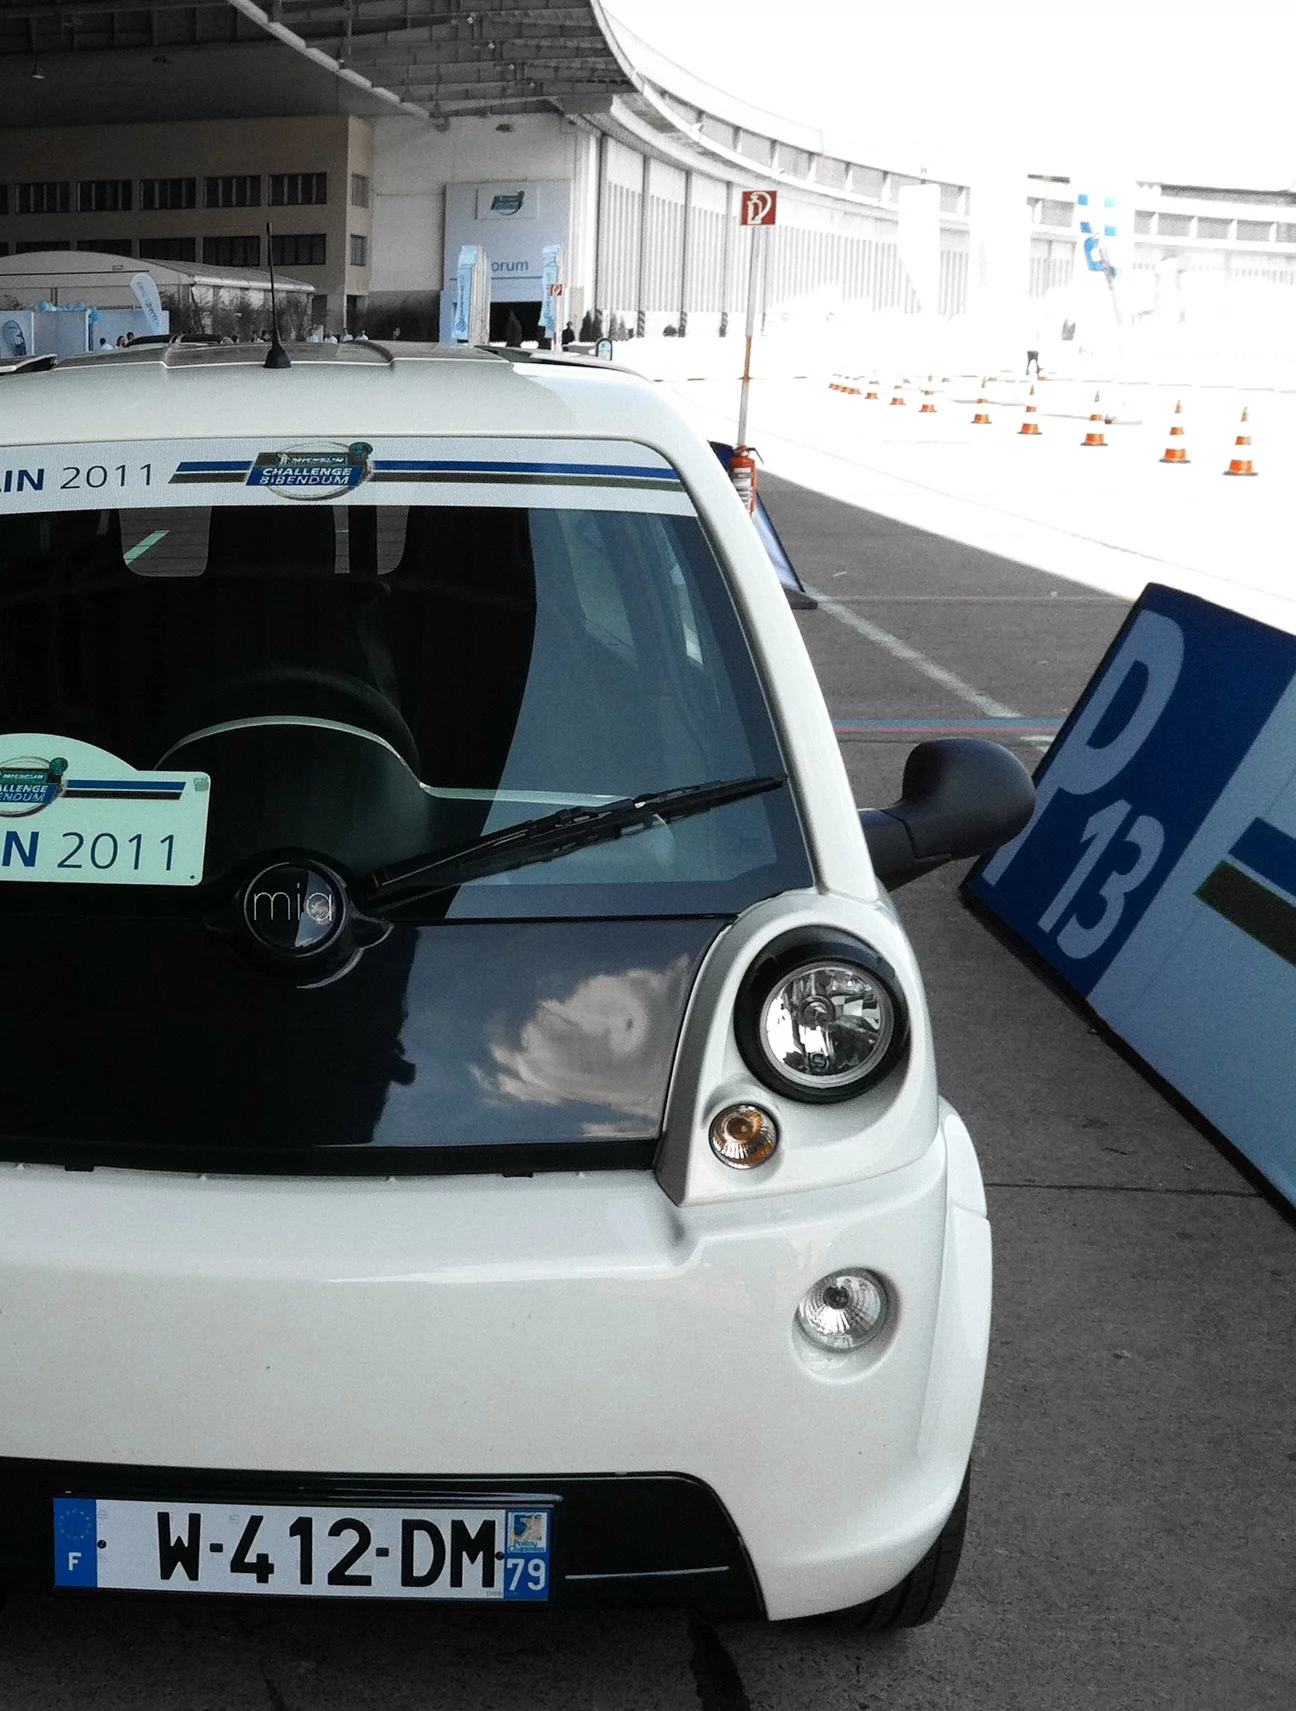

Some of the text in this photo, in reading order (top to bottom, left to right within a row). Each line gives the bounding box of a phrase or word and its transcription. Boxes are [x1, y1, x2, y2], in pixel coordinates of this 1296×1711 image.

[491, 259, 529, 272] orum
[60, 463, 153, 490] 2011
[259, 475, 350, 485] BIBENDUM
[262, 467, 353, 476] CHALLENGE
[984, 608, 1185, 887] P
[57, 832, 177, 872] 2011
[1037, 799, 1165, 960] 13
[254, 882, 332, 922] mia
[68, 1511, 546, 1591] F W-412-DM 79
